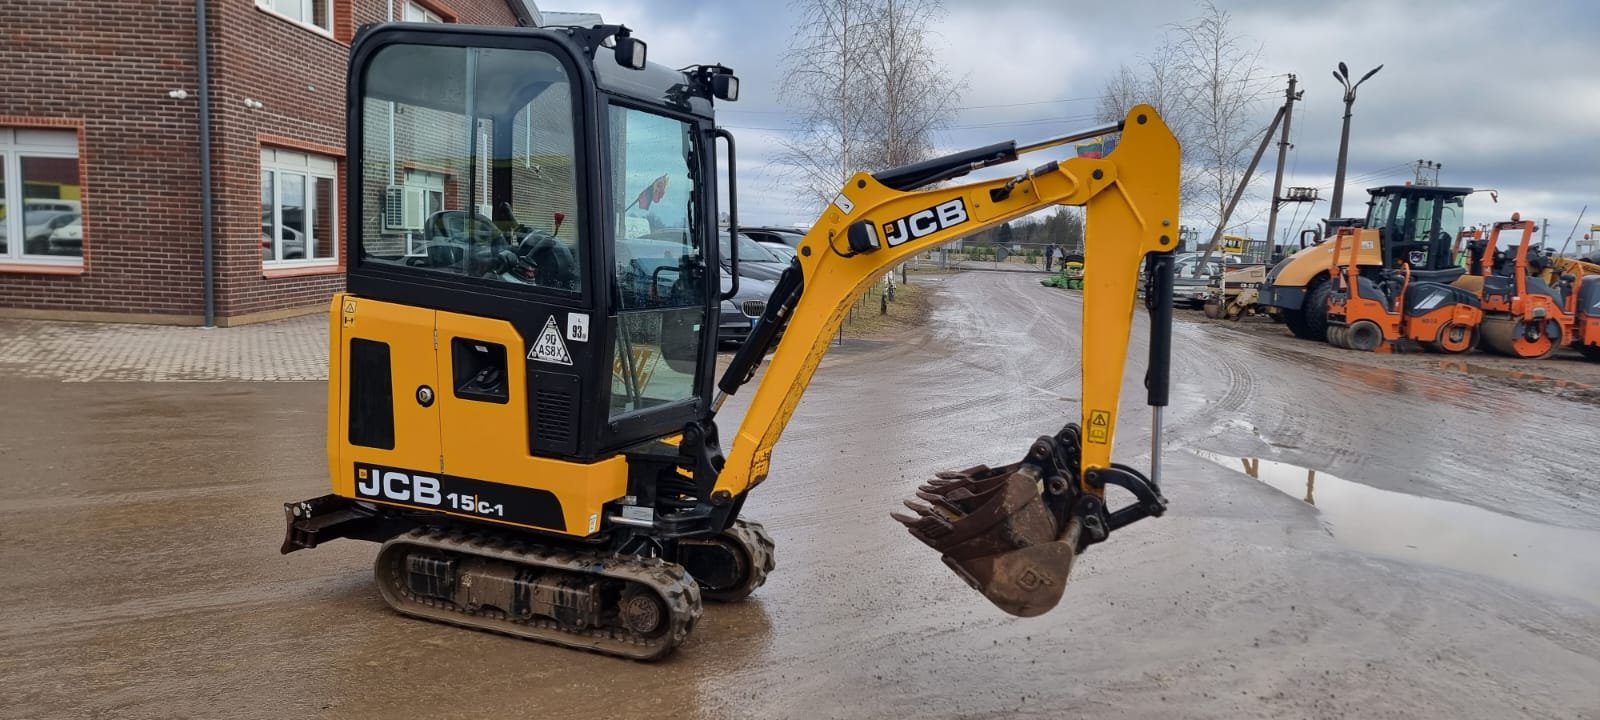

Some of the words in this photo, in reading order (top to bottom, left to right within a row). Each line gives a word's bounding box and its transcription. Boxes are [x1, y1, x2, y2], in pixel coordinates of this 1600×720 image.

[888, 200, 967, 246] JCB
[572, 325, 582, 338] 93
[539, 344, 562, 357] AS8X
[359, 469, 441, 505] JCB
